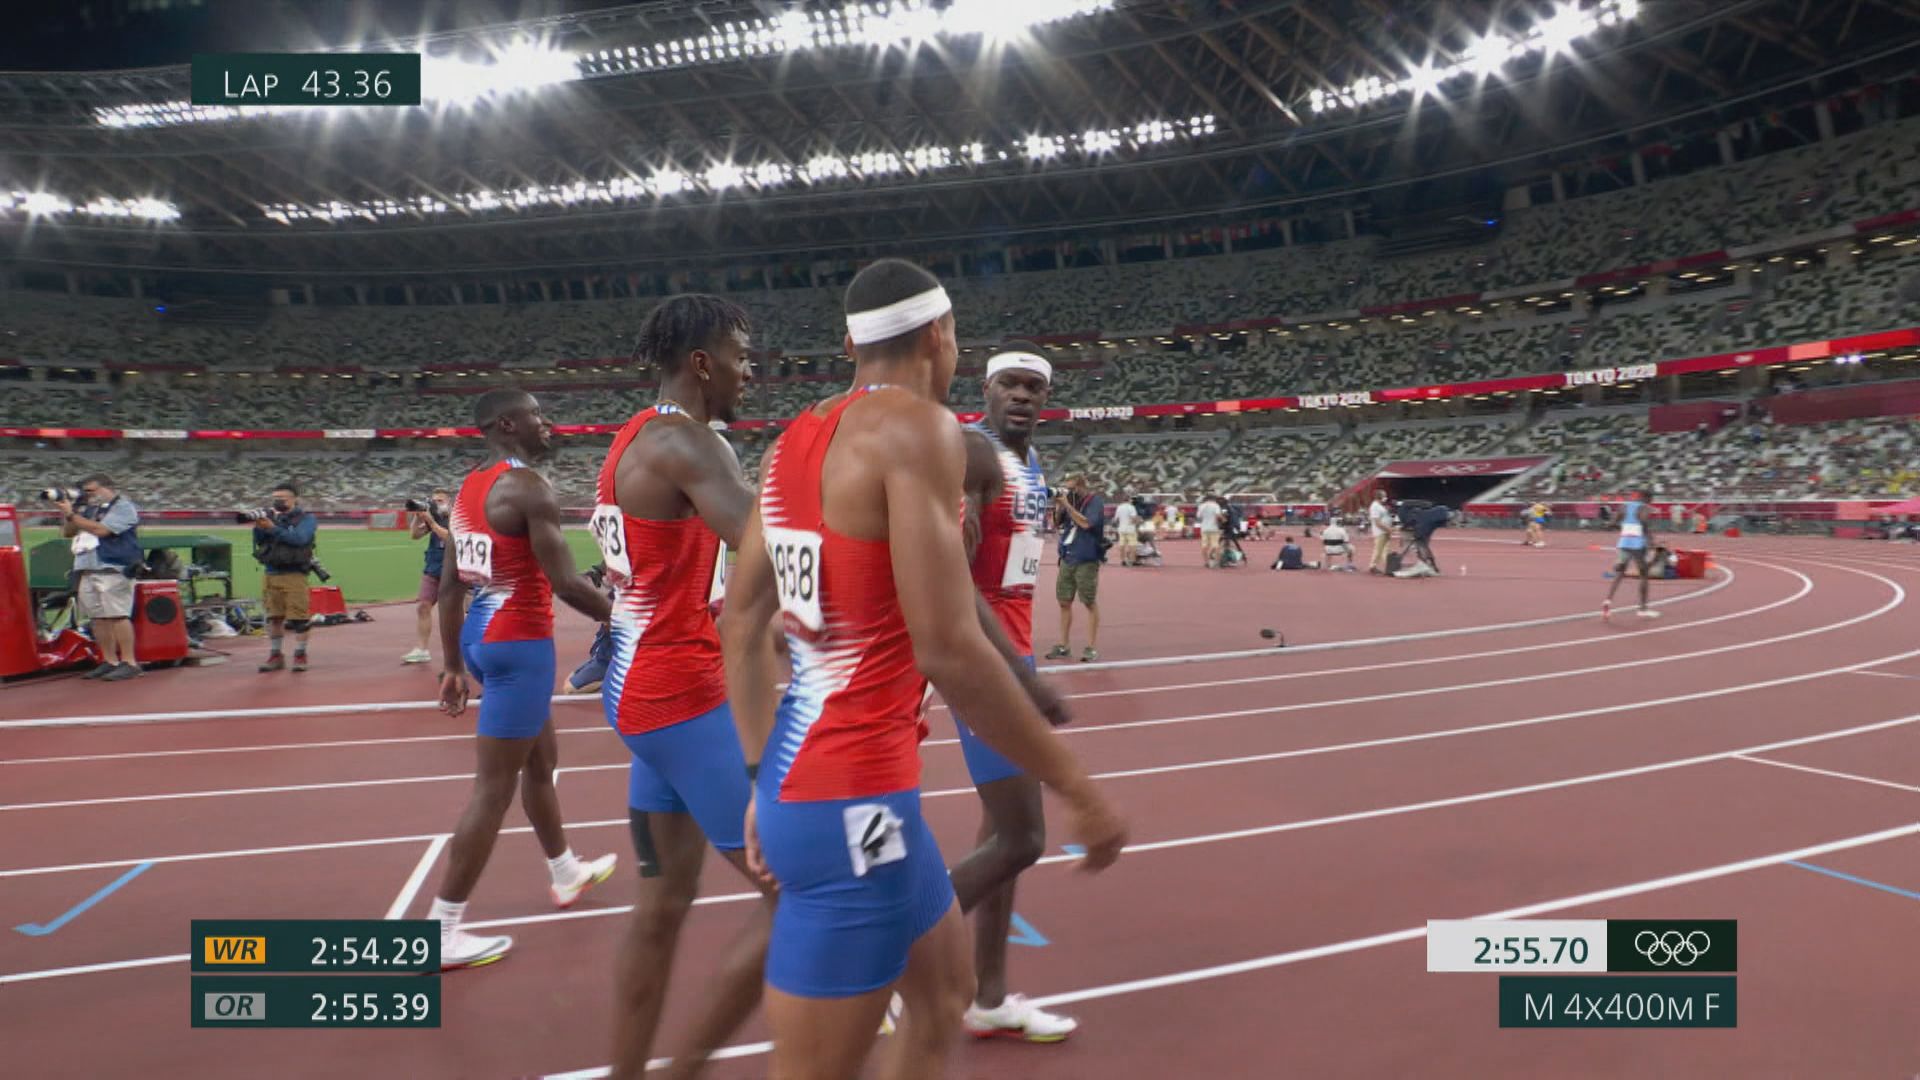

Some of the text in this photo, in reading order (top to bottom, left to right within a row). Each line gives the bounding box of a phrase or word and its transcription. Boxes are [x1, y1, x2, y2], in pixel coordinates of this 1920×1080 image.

[1566, 363, 1656, 385] TOKYO 2020
[1298, 391, 1370, 408] TOKYO 2020
[768, 542, 813, 602] 958
